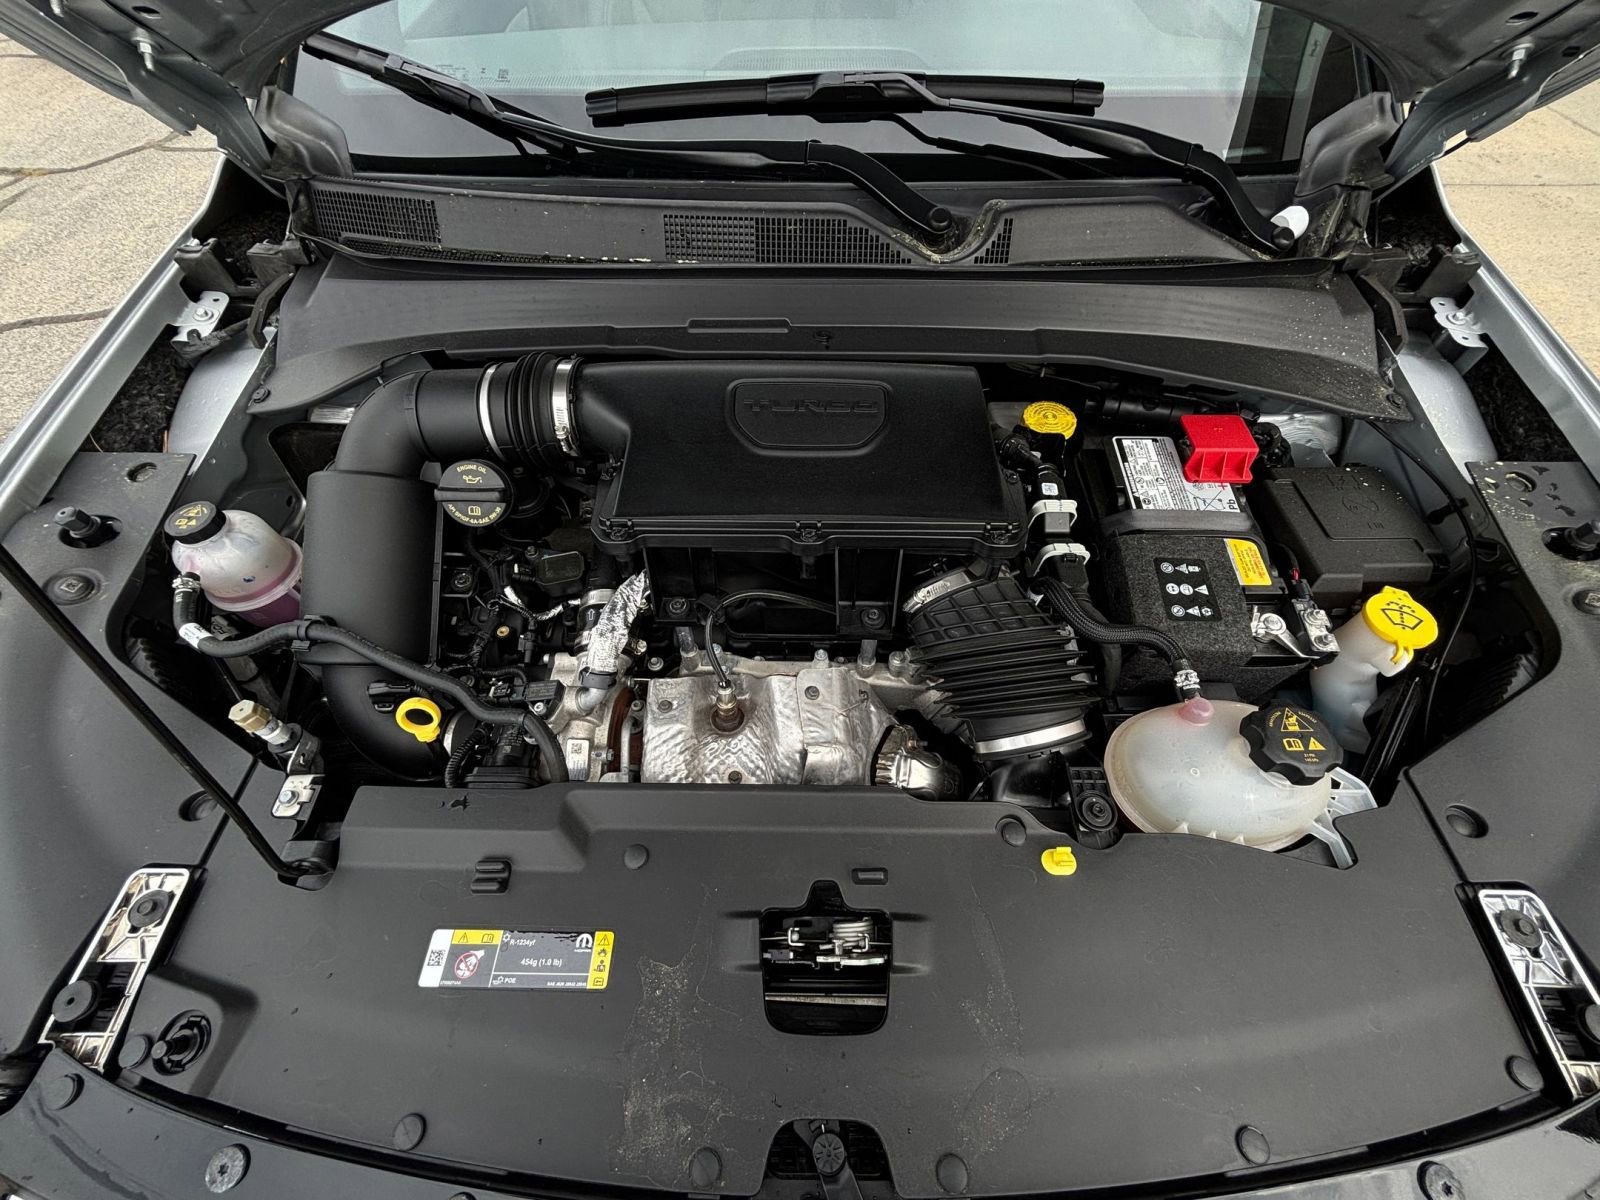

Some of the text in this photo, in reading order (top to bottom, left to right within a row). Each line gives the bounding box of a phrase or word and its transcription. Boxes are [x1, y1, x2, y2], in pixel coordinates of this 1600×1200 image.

[743, 399, 879, 413] TURBO
[456, 464, 487, 474] ENGINE OIL
[1226, 498, 1238, 510] Pb
[509, 938, 536, 948] R-1234yf
[520, 958, 538, 967] 454g
